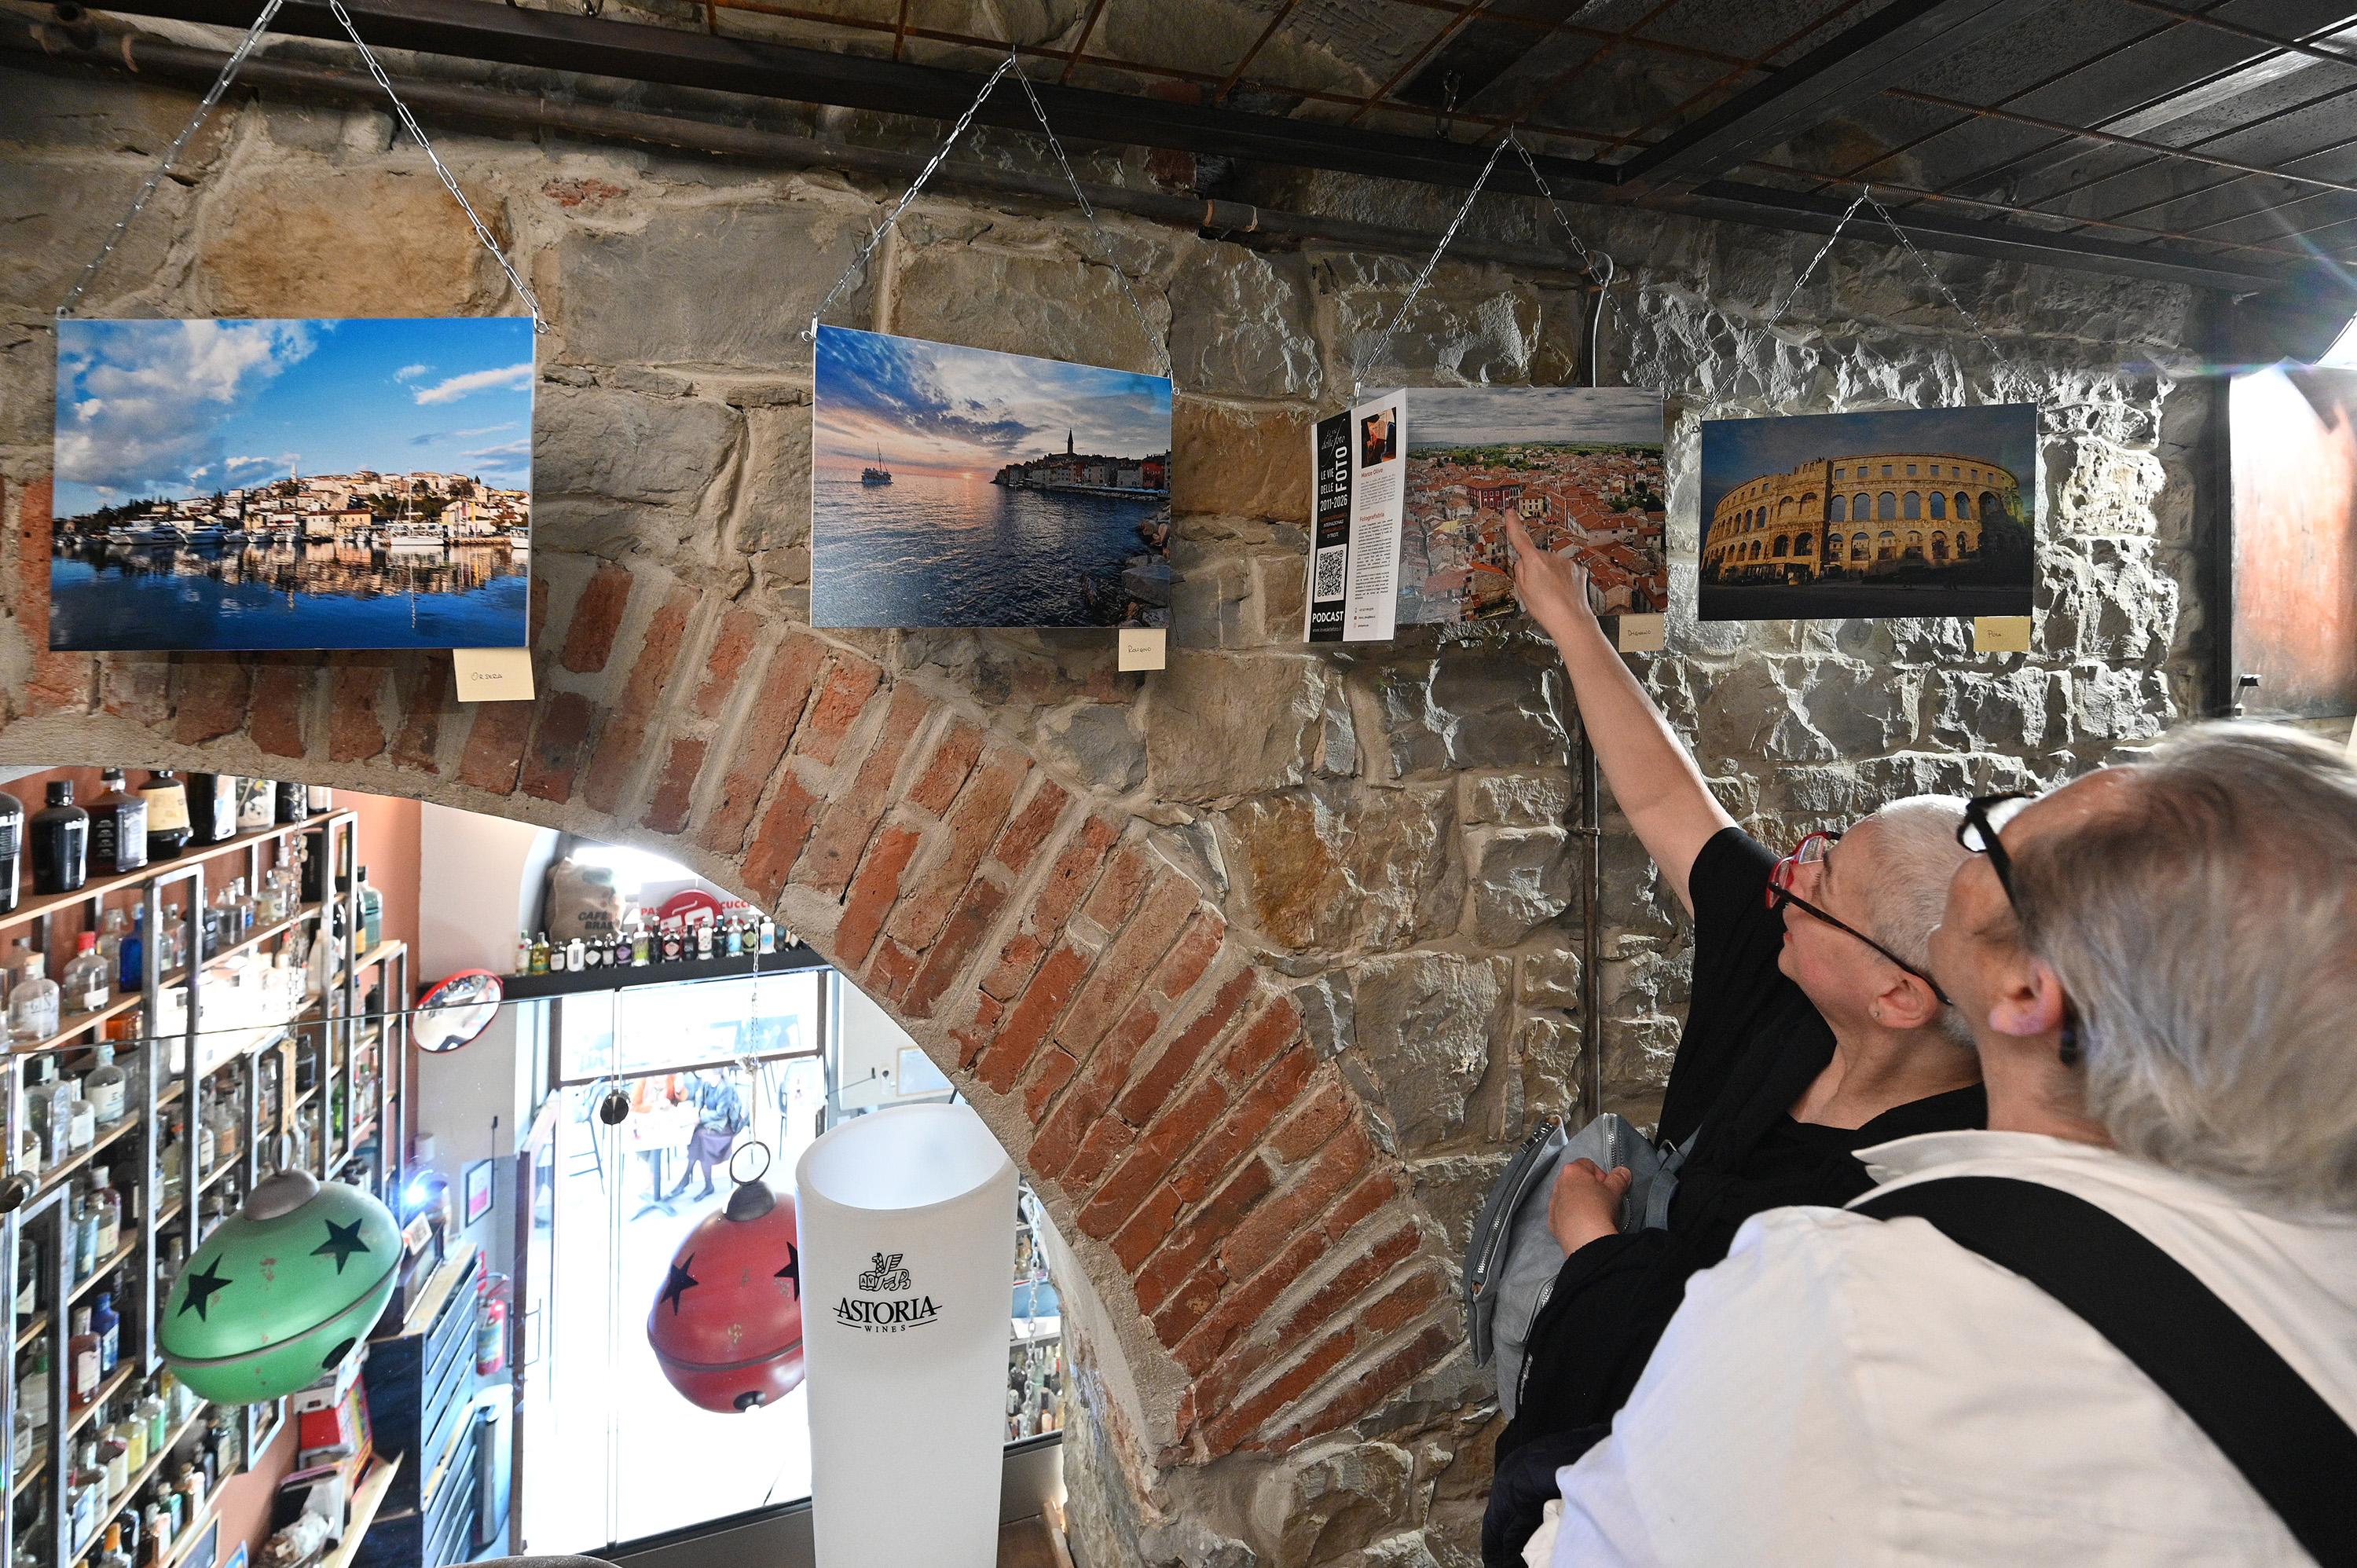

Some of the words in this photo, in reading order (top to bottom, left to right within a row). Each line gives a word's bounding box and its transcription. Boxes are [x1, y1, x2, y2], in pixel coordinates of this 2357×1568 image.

[1335, 446, 1347, 493] FOTO
[1321, 482, 1334, 495] DELLE
[1320, 494, 1347, 511] 2011-2026
[1312, 611, 1343, 623] PODCAST
[833, 1296, 942, 1324] ASTORIA
[864, 1324, 906, 1333] WINES
